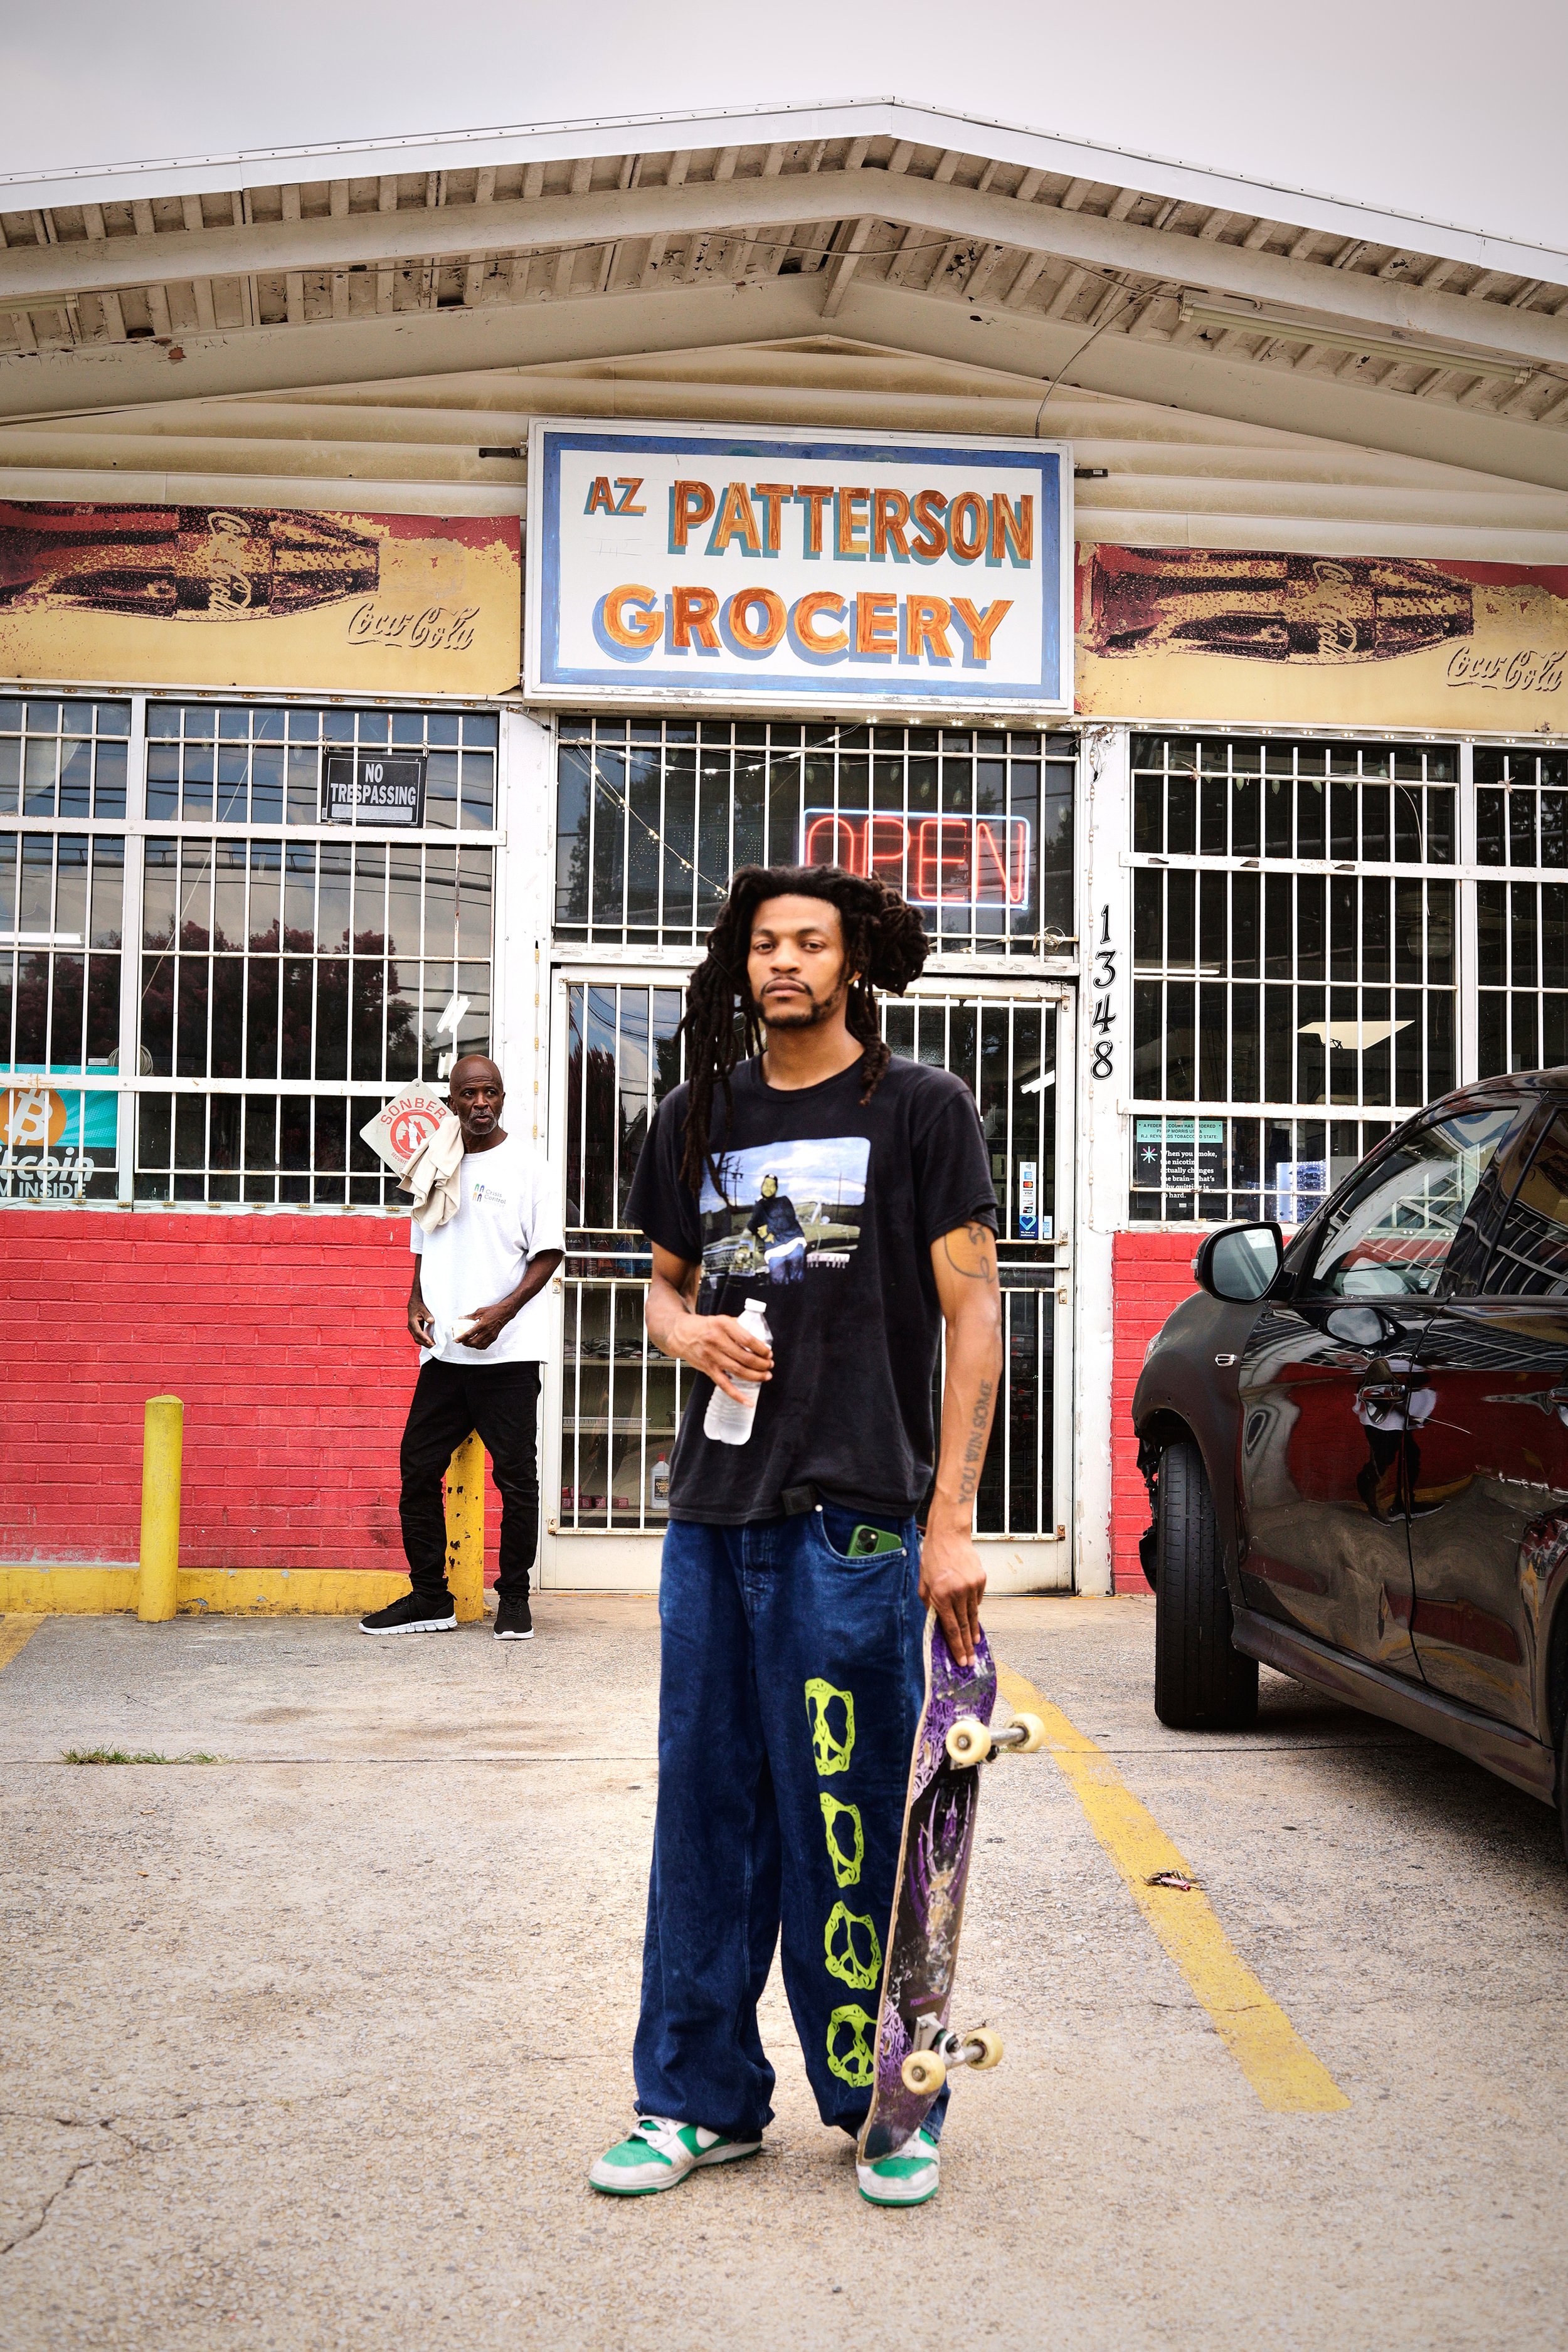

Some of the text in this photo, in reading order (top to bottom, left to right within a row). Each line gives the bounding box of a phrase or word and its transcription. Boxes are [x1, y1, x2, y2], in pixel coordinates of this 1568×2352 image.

[585, 476, 1034, 567] AZ PATTERSON
[593, 584, 1014, 666] GROCERY
[365, 763, 384, 783] NO
[331, 783, 416, 805] TRESPASSING
[807, 817, 1024, 902] OPEN
[1091, 903, 1117, 1080] 1348
[380, 1097, 447, 1125] SONBER
[0, 1146, 94, 1182] tcoin
[391, 1152, 407, 1165] SECURIT
[1199, 1150, 1217, 1158] moke,
[1187, 1167, 1214, 1175] chnges
[19, 1182, 87, 1199] INSIDE
[484, 1194, 506, 1204] Control
[485, 1189, 502, 1198] Crisis
[958, 1379, 993, 1505] YOU WIN SOME
